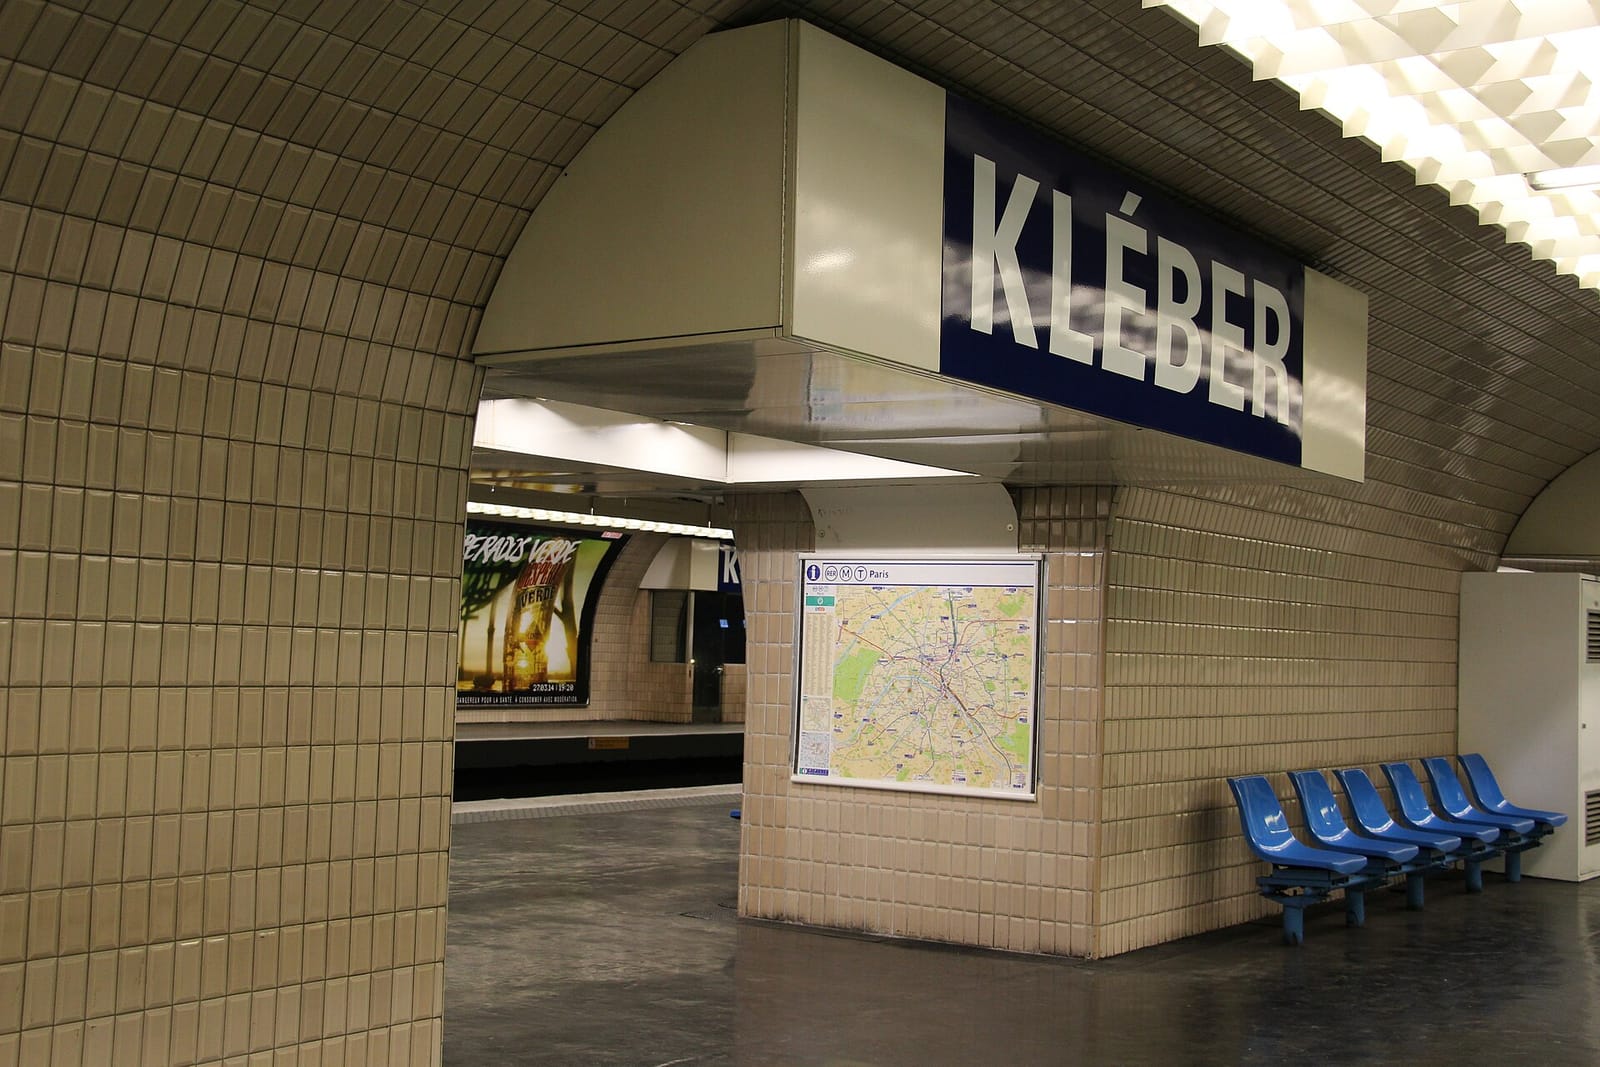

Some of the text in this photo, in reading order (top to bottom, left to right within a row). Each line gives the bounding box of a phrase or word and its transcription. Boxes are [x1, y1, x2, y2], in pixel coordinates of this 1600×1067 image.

[971, 153, 1291, 426] KLÉBER
[528, 539, 582, 565] VERDE
[723, 550, 740, 584] K
[869, 570, 889, 579] Paris
[481, 696, 492, 704] POUR
[493, 696, 499, 704] LA
